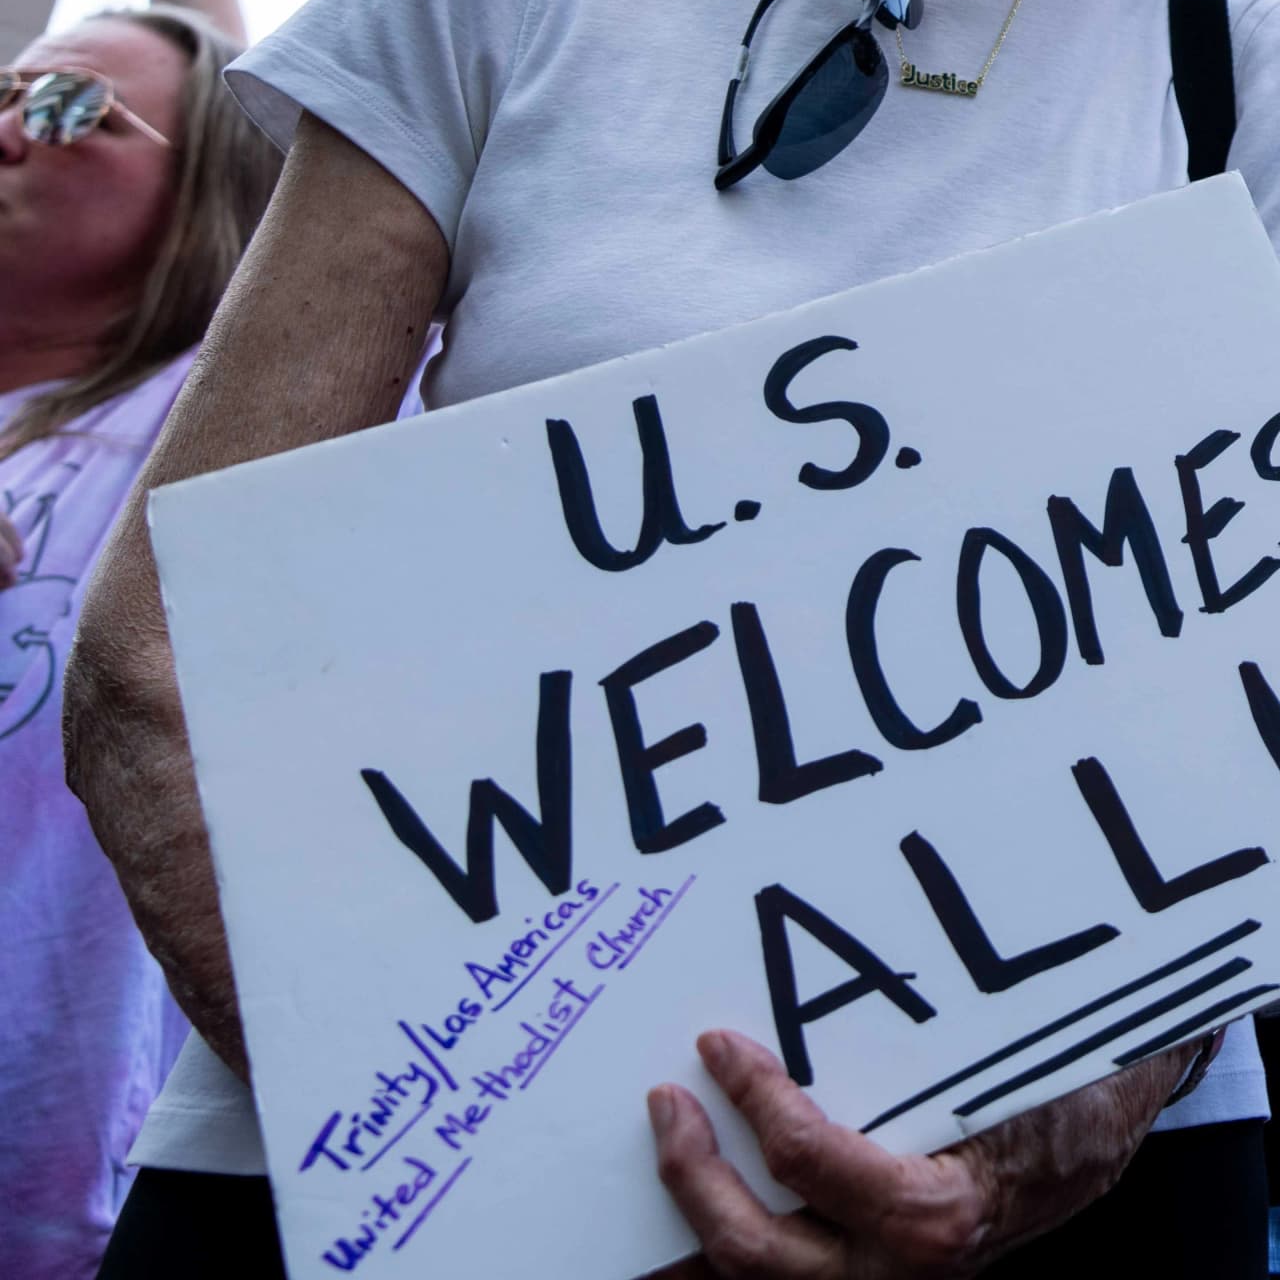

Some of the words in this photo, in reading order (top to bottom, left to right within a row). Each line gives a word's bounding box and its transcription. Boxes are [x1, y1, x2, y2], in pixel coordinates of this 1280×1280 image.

[901, 62, 978, 96] Justice
[545, 335, 921, 571] U.S.
[434, 976, 592, 1151] Methodist
[585, 886, 673, 970] Church
